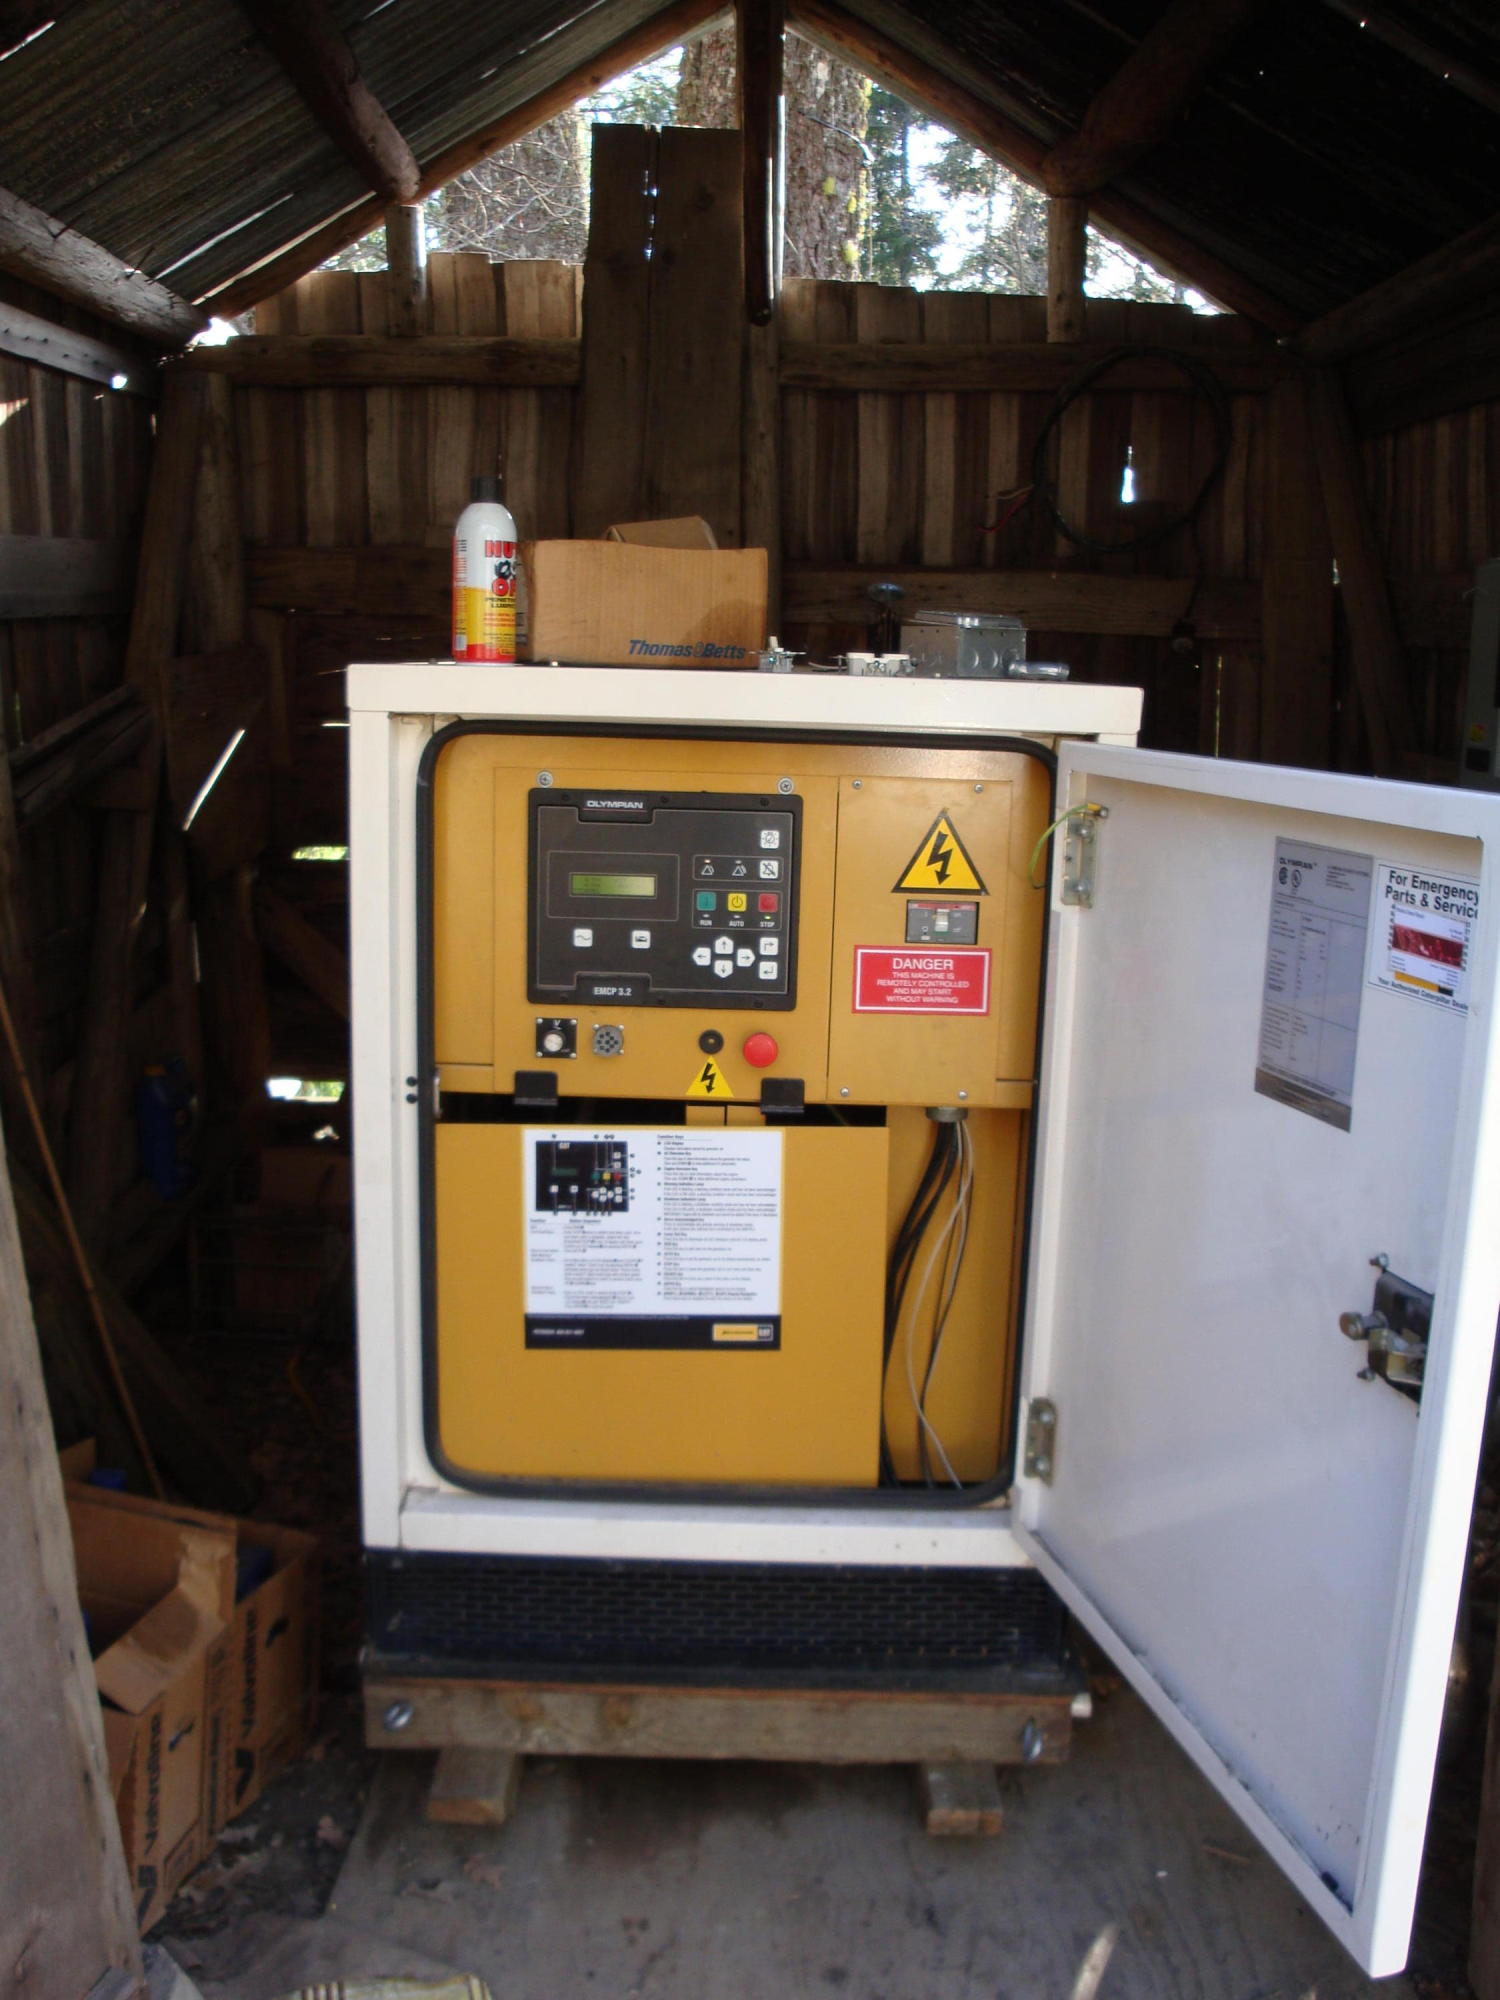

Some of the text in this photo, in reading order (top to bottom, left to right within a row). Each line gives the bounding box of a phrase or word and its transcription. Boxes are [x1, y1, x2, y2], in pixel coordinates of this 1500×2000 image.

[628, 640, 693, 657] Thomas
[704, 643, 746, 660] Betts
[586, 799, 644, 809] OLYMPIAN
[1388, 870, 1408, 886] For
[1385, 885, 1416, 905] Parts
[1420, 893, 1429, 908] &
[728, 920, 745, 928] AUTO
[892, 958, 954, 970] DANGER
[946, 972, 954, 980] IS
[918, 980, 970, 988] CONTROLLED
[594, 986, 632, 996] EMCP 3.2
[928, 988, 952, 996] START
[922, 996, 959, 1004] WARNING
